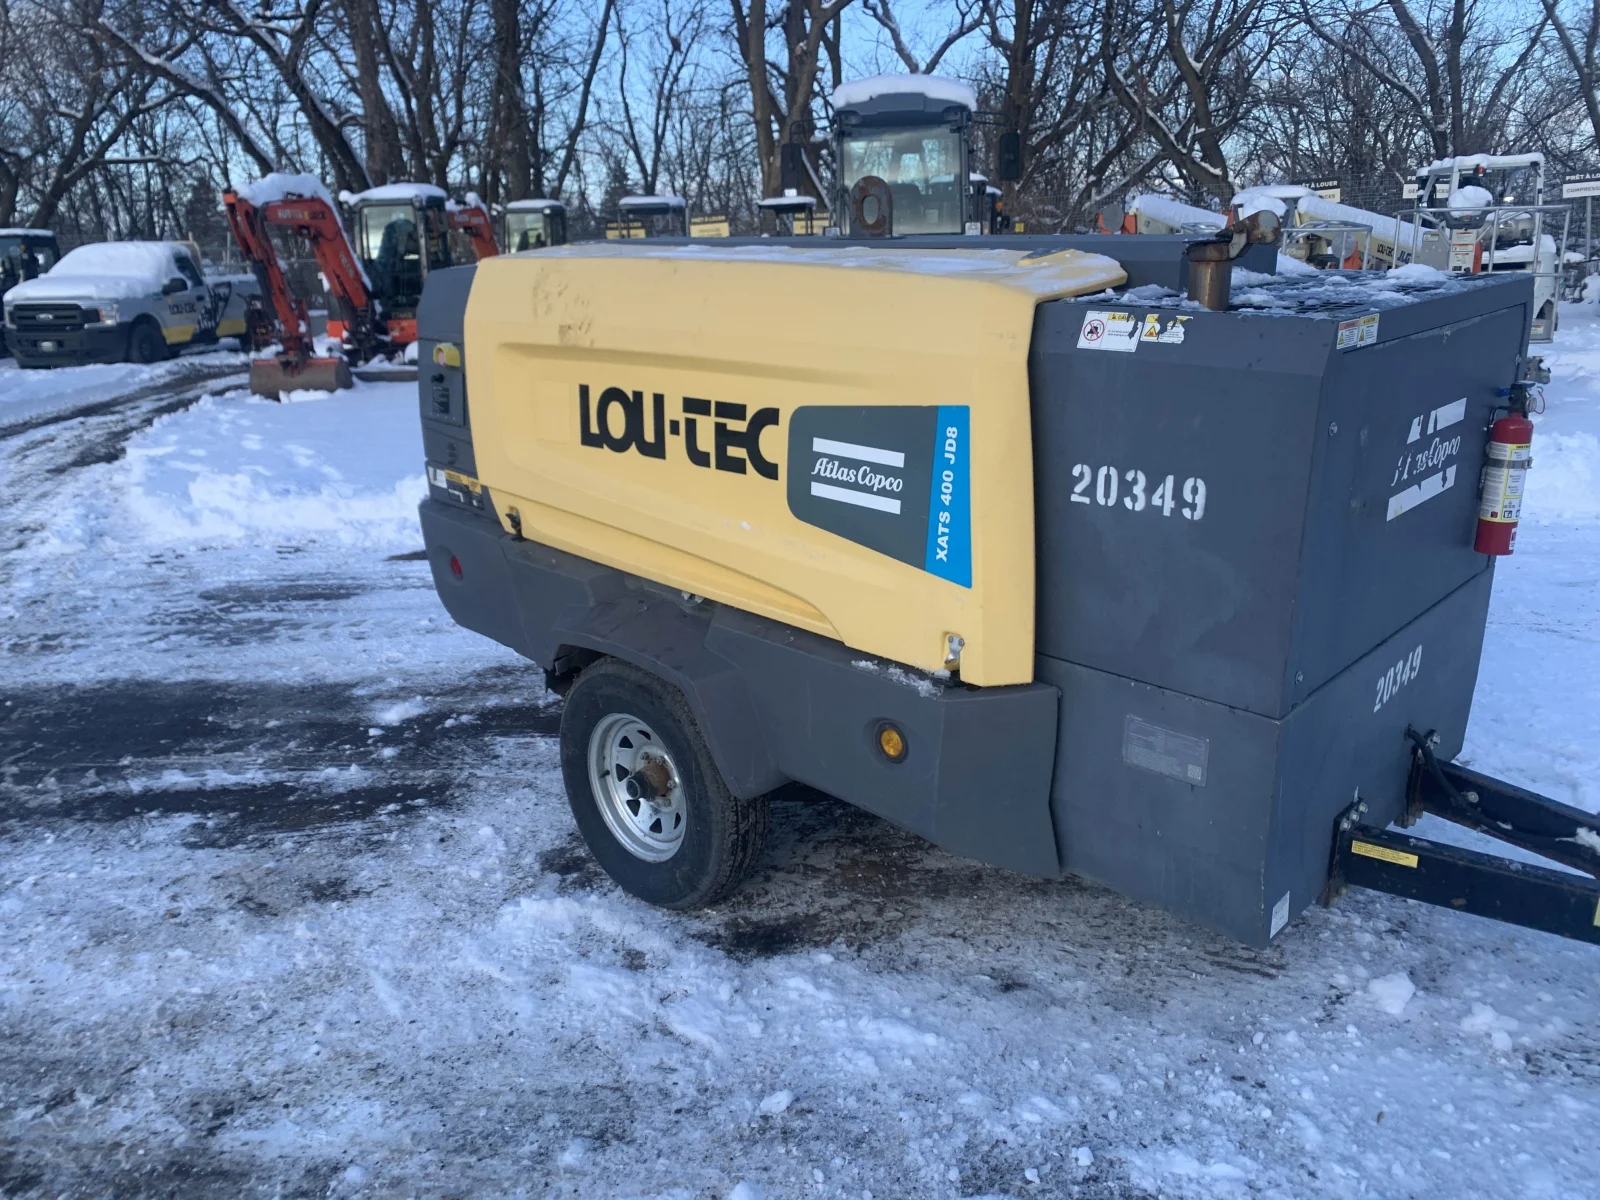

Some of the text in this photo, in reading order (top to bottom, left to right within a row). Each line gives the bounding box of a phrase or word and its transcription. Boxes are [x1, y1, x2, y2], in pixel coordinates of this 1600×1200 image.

[1316, 180, 1338, 188] LOUER
[1397, 250, 1413, 265] JLG
[578, 383, 780, 481] LOU-TEC
[811, 457, 903, 492] Atlas Copco
[935, 426, 958, 563] XATS 400 JD8
[1070, 463, 1207, 521] 20349
[1373, 644, 1423, 713] 20349
